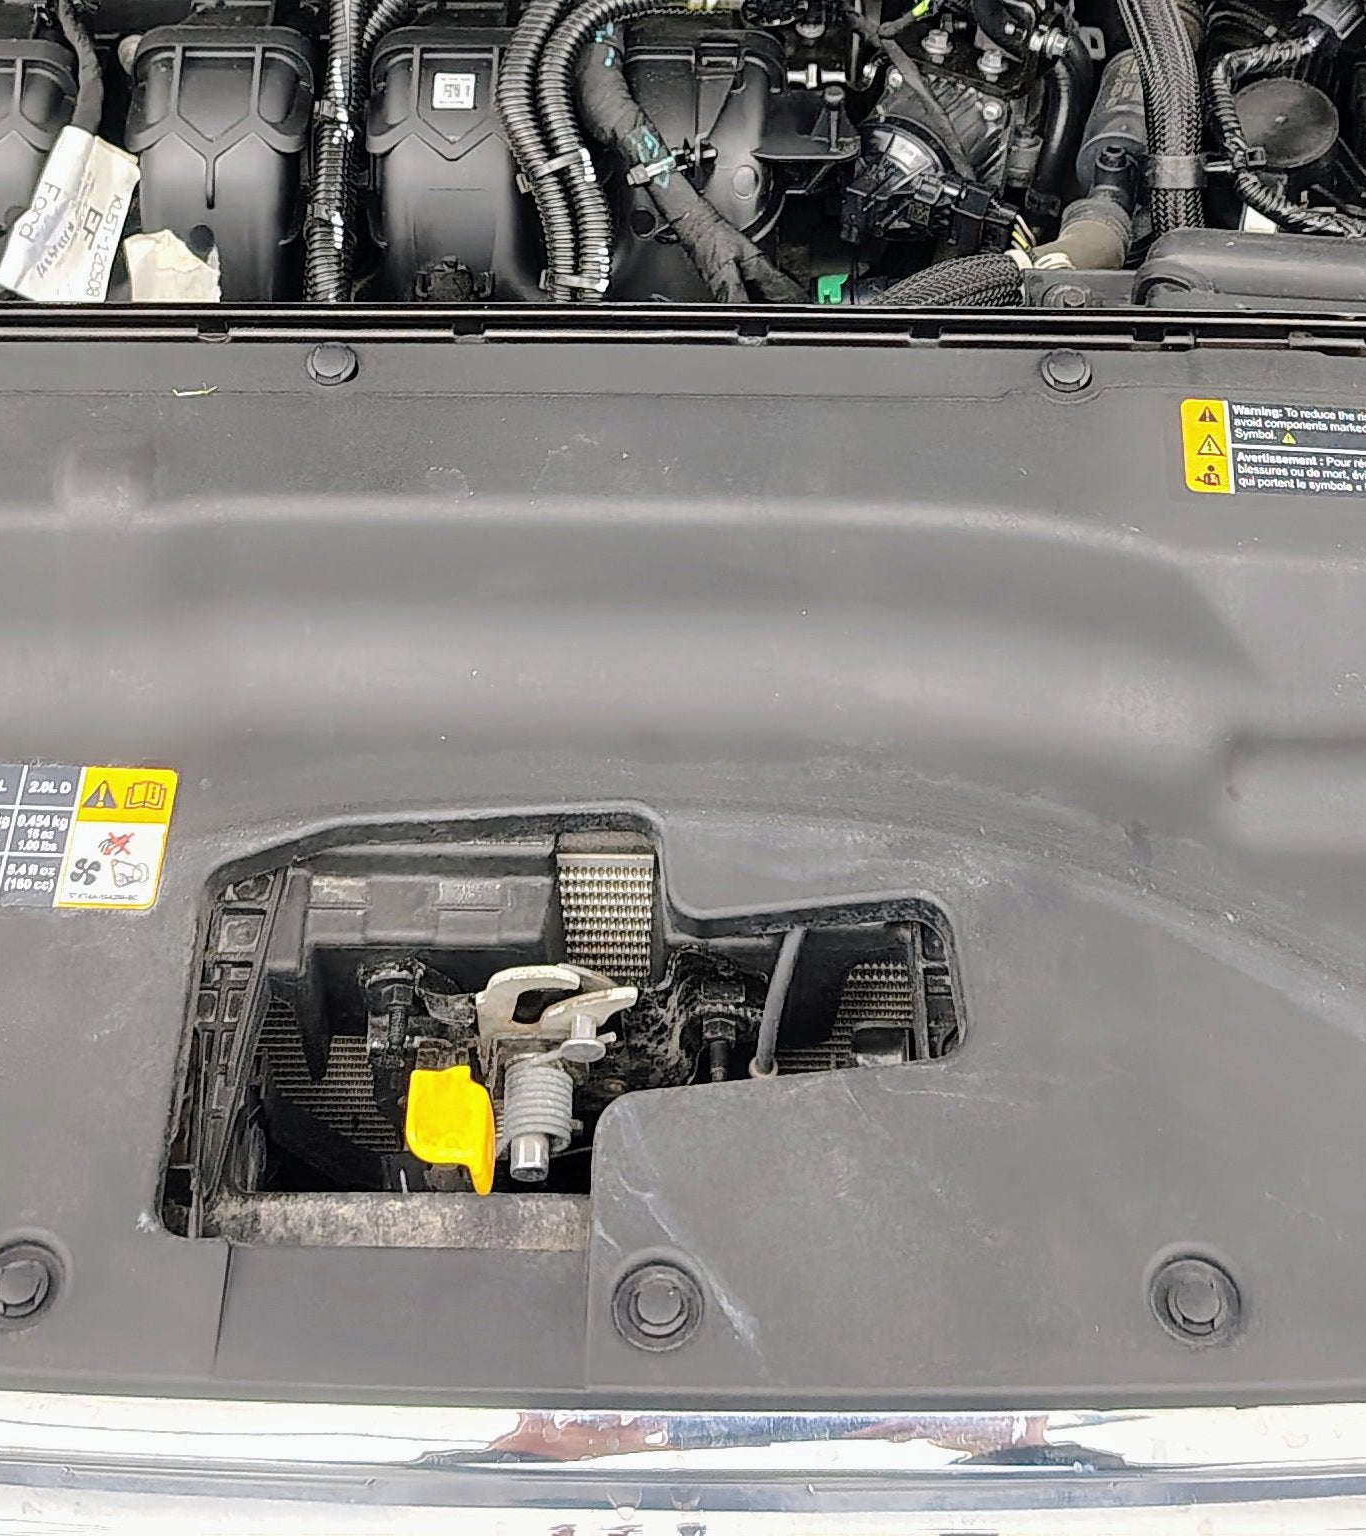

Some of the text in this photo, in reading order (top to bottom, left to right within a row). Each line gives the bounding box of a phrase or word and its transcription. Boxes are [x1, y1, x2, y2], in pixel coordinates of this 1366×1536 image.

[19, 181, 61, 242] Ford
[84, 207, 103, 250] EF
[1232, 404, 1283, 418] Warning:
[1285, 407, 1298, 417] To
[1299, 408, 1336, 419] reduce
[1338, 410, 1355, 420] the
[1233, 416, 1262, 426] avoid
[1263, 418, 1328, 432] components
[1234, 428, 1277, 441] Symbol.
[1236, 451, 1317, 466] Avertissement
[1325, 456, 1352, 468] Pour
[1237, 463, 1288, 476] blessures
[1290, 468, 1304, 477] ou
[1306, 467, 1320, 478] de
[1238, 475, 1255, 488] qui
[1257, 476, 1294, 490] portent
[1296, 478, 1307, 488] le
[1309, 479, 1353, 493] symbole
[27, 780, 72, 794] 2.0L D
[50, 814, 69, 830] kg
[40, 828, 55, 839] oz
[40, 864, 57, 876] oz
[32, 878, 55, 892] cc)
